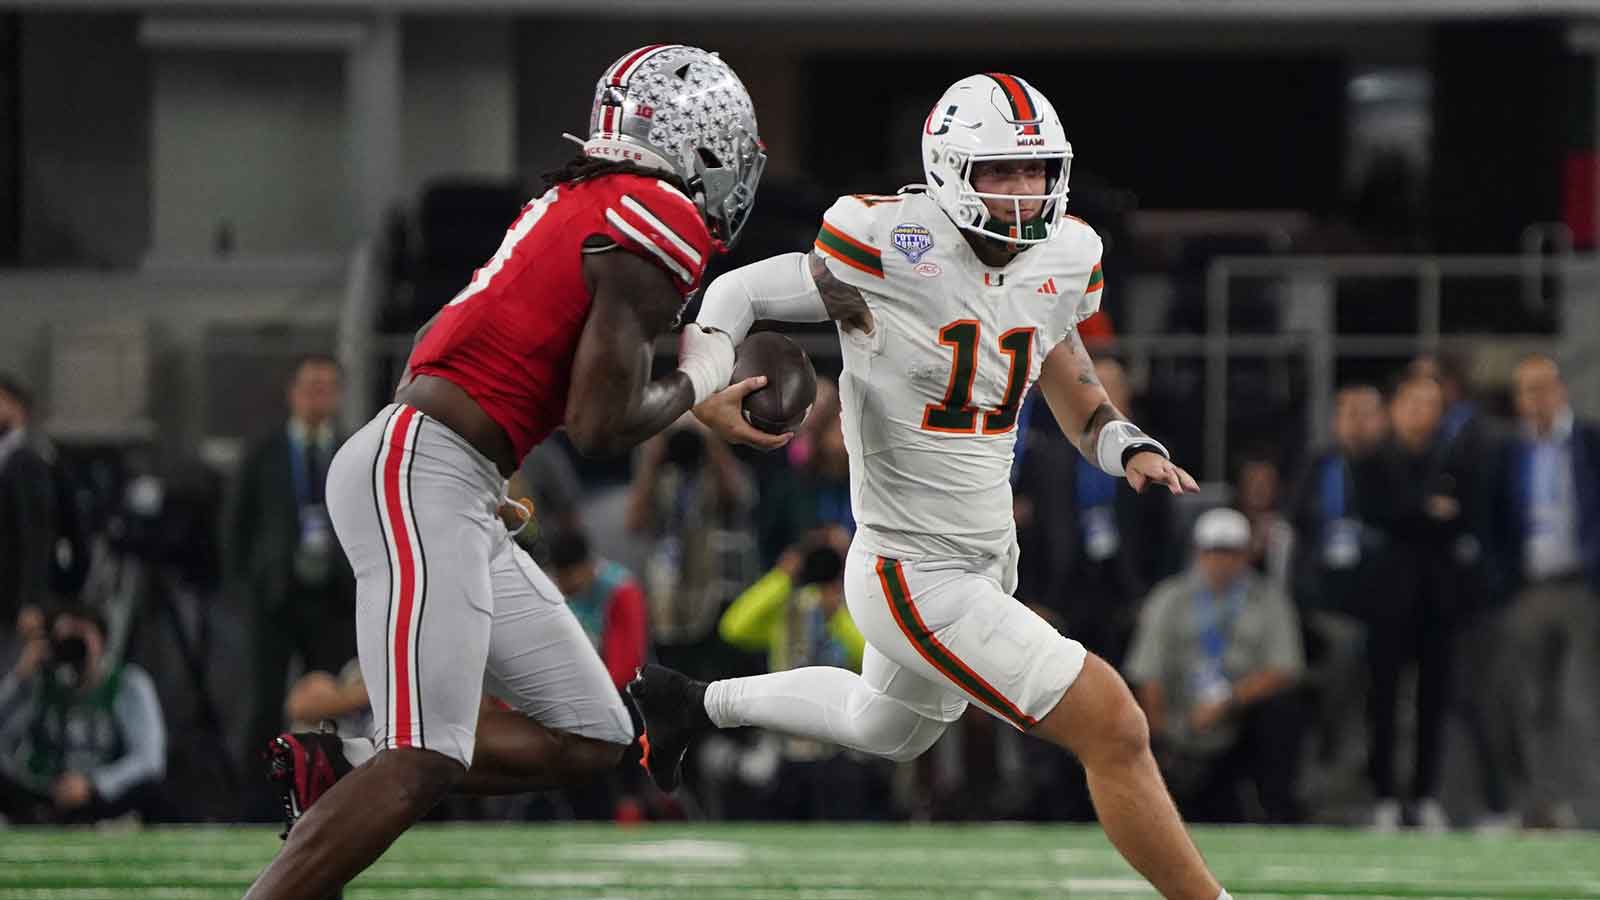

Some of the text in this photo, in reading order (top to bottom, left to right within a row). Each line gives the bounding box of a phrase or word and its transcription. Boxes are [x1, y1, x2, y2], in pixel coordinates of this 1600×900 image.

[1017, 138, 1045, 147] MIAMI
[895, 227, 929, 235] GOODYEAR
[895, 234, 929, 246] COTTON
[984, 271, 1004, 287] U
[921, 319, 1036, 434] 11
